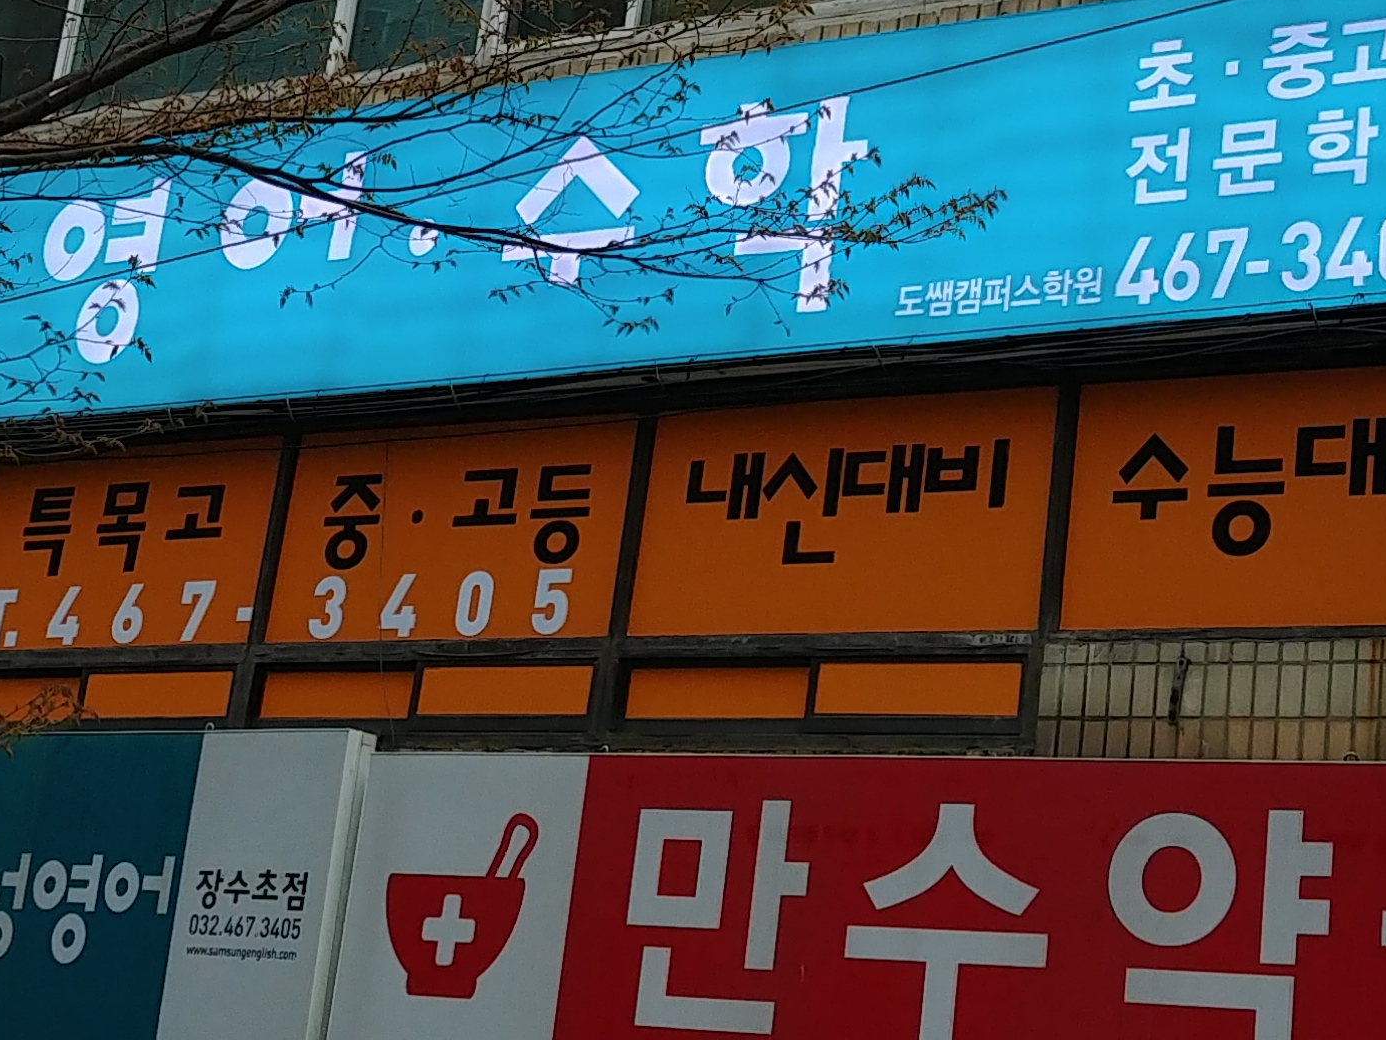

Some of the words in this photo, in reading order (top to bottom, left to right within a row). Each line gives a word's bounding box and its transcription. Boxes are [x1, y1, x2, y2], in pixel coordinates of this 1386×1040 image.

[894, 265, 1103, 319] 도쌤캠퍼스학원
[685, 437, 1011, 565] 내신대비
[22, 480, 228, 577] 특목고
[195, 868, 309, 912] 장수초점
[188, 913, 302, 940] 032.467.3405
